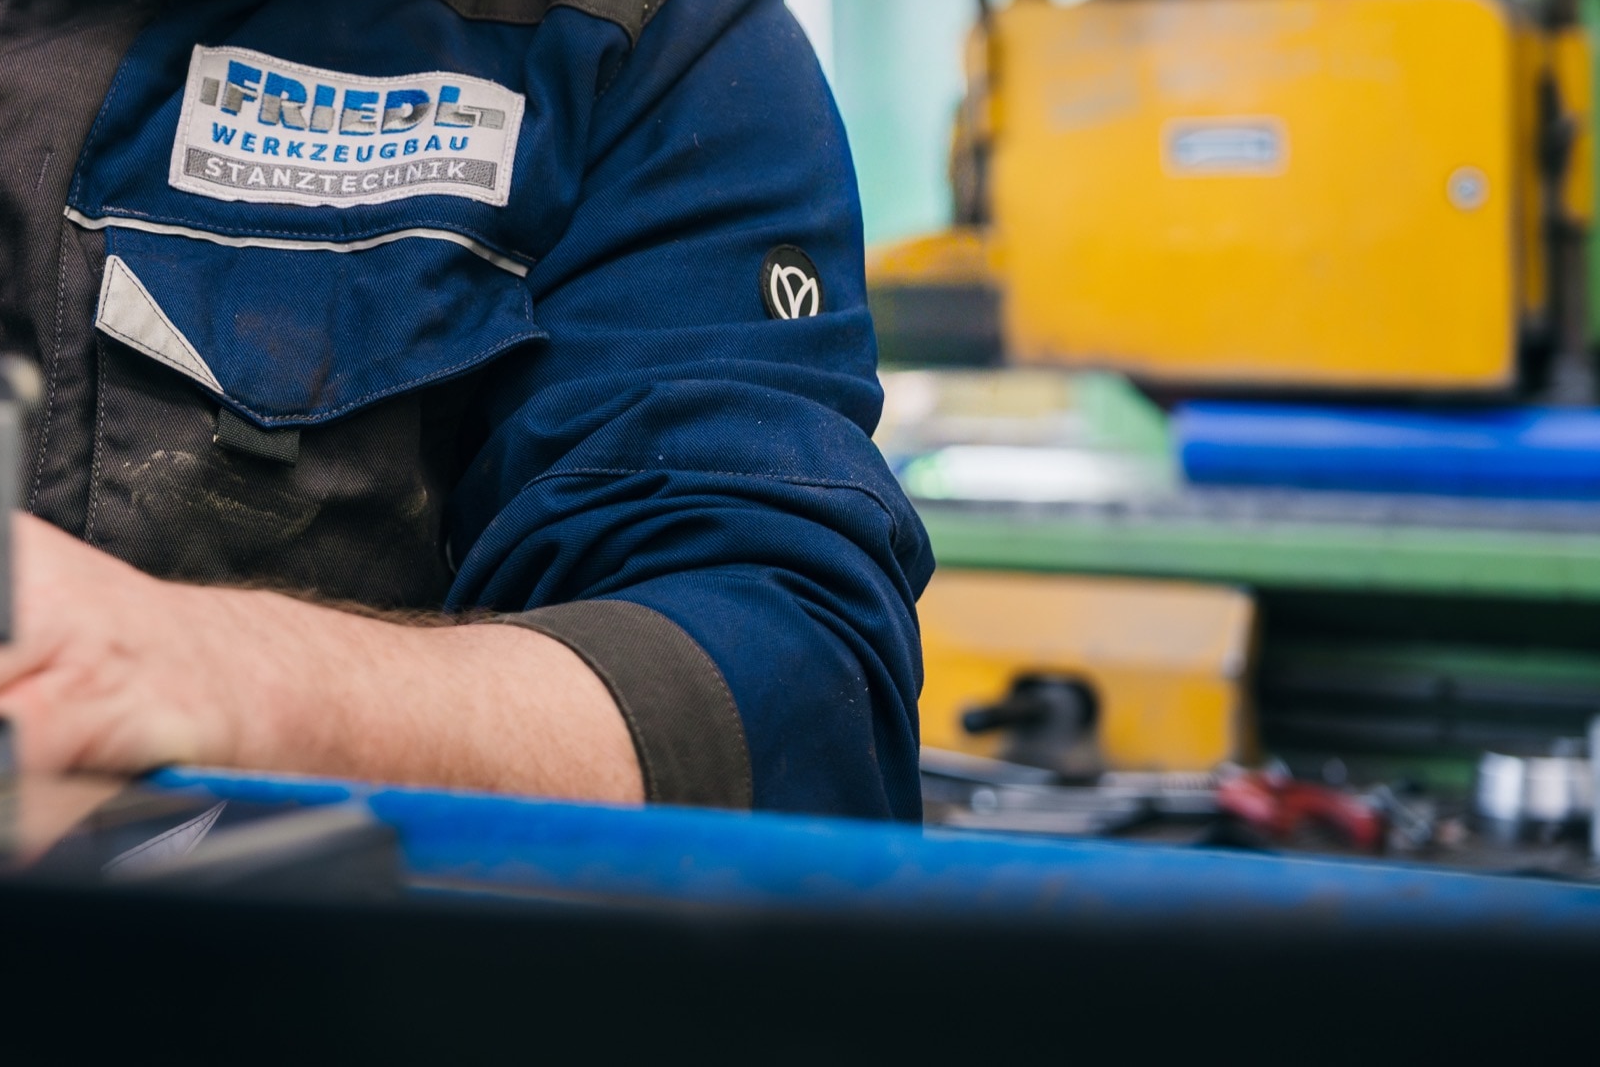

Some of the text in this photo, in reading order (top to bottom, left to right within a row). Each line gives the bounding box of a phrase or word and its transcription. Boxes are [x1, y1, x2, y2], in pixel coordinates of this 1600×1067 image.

[220, 60, 475, 135] FRIEDL
[211, 122, 469, 163] WERKZEUGBAU
[205, 158, 466, 193] STANZTECHNIK
